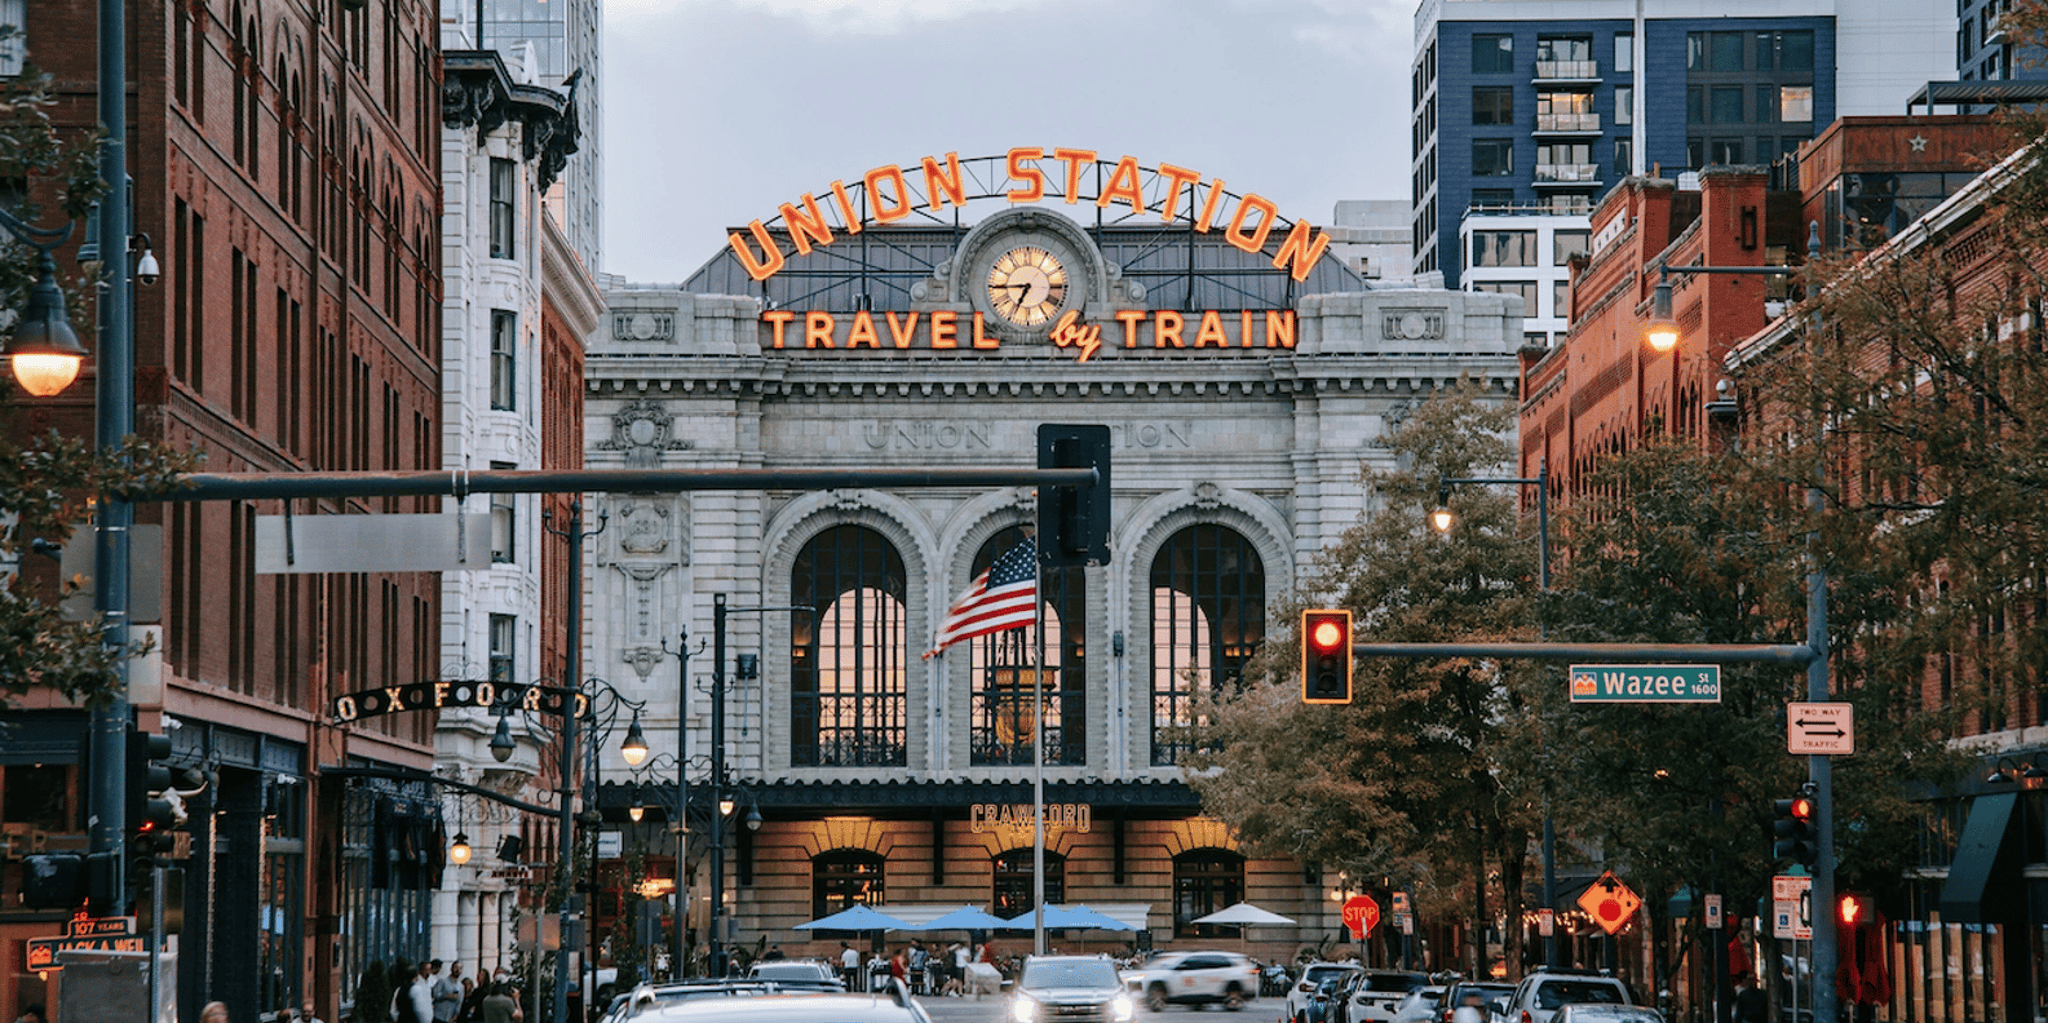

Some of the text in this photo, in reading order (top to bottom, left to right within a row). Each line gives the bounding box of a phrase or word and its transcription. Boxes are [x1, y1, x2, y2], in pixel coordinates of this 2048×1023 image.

[728, 147, 1332, 284] UNION STATION
[763, 309, 1295, 363] TRAVEL by TRAIN
[863, 424, 992, 449] UNION
[1603, 672, 1709, 695] Wazee St
[1691, 684, 1717, 694] 1600
[337, 682, 588, 721] OXFORD
[1345, 907, 1376, 921] STOP
[75, 922, 124, 934] 107 YEARS
